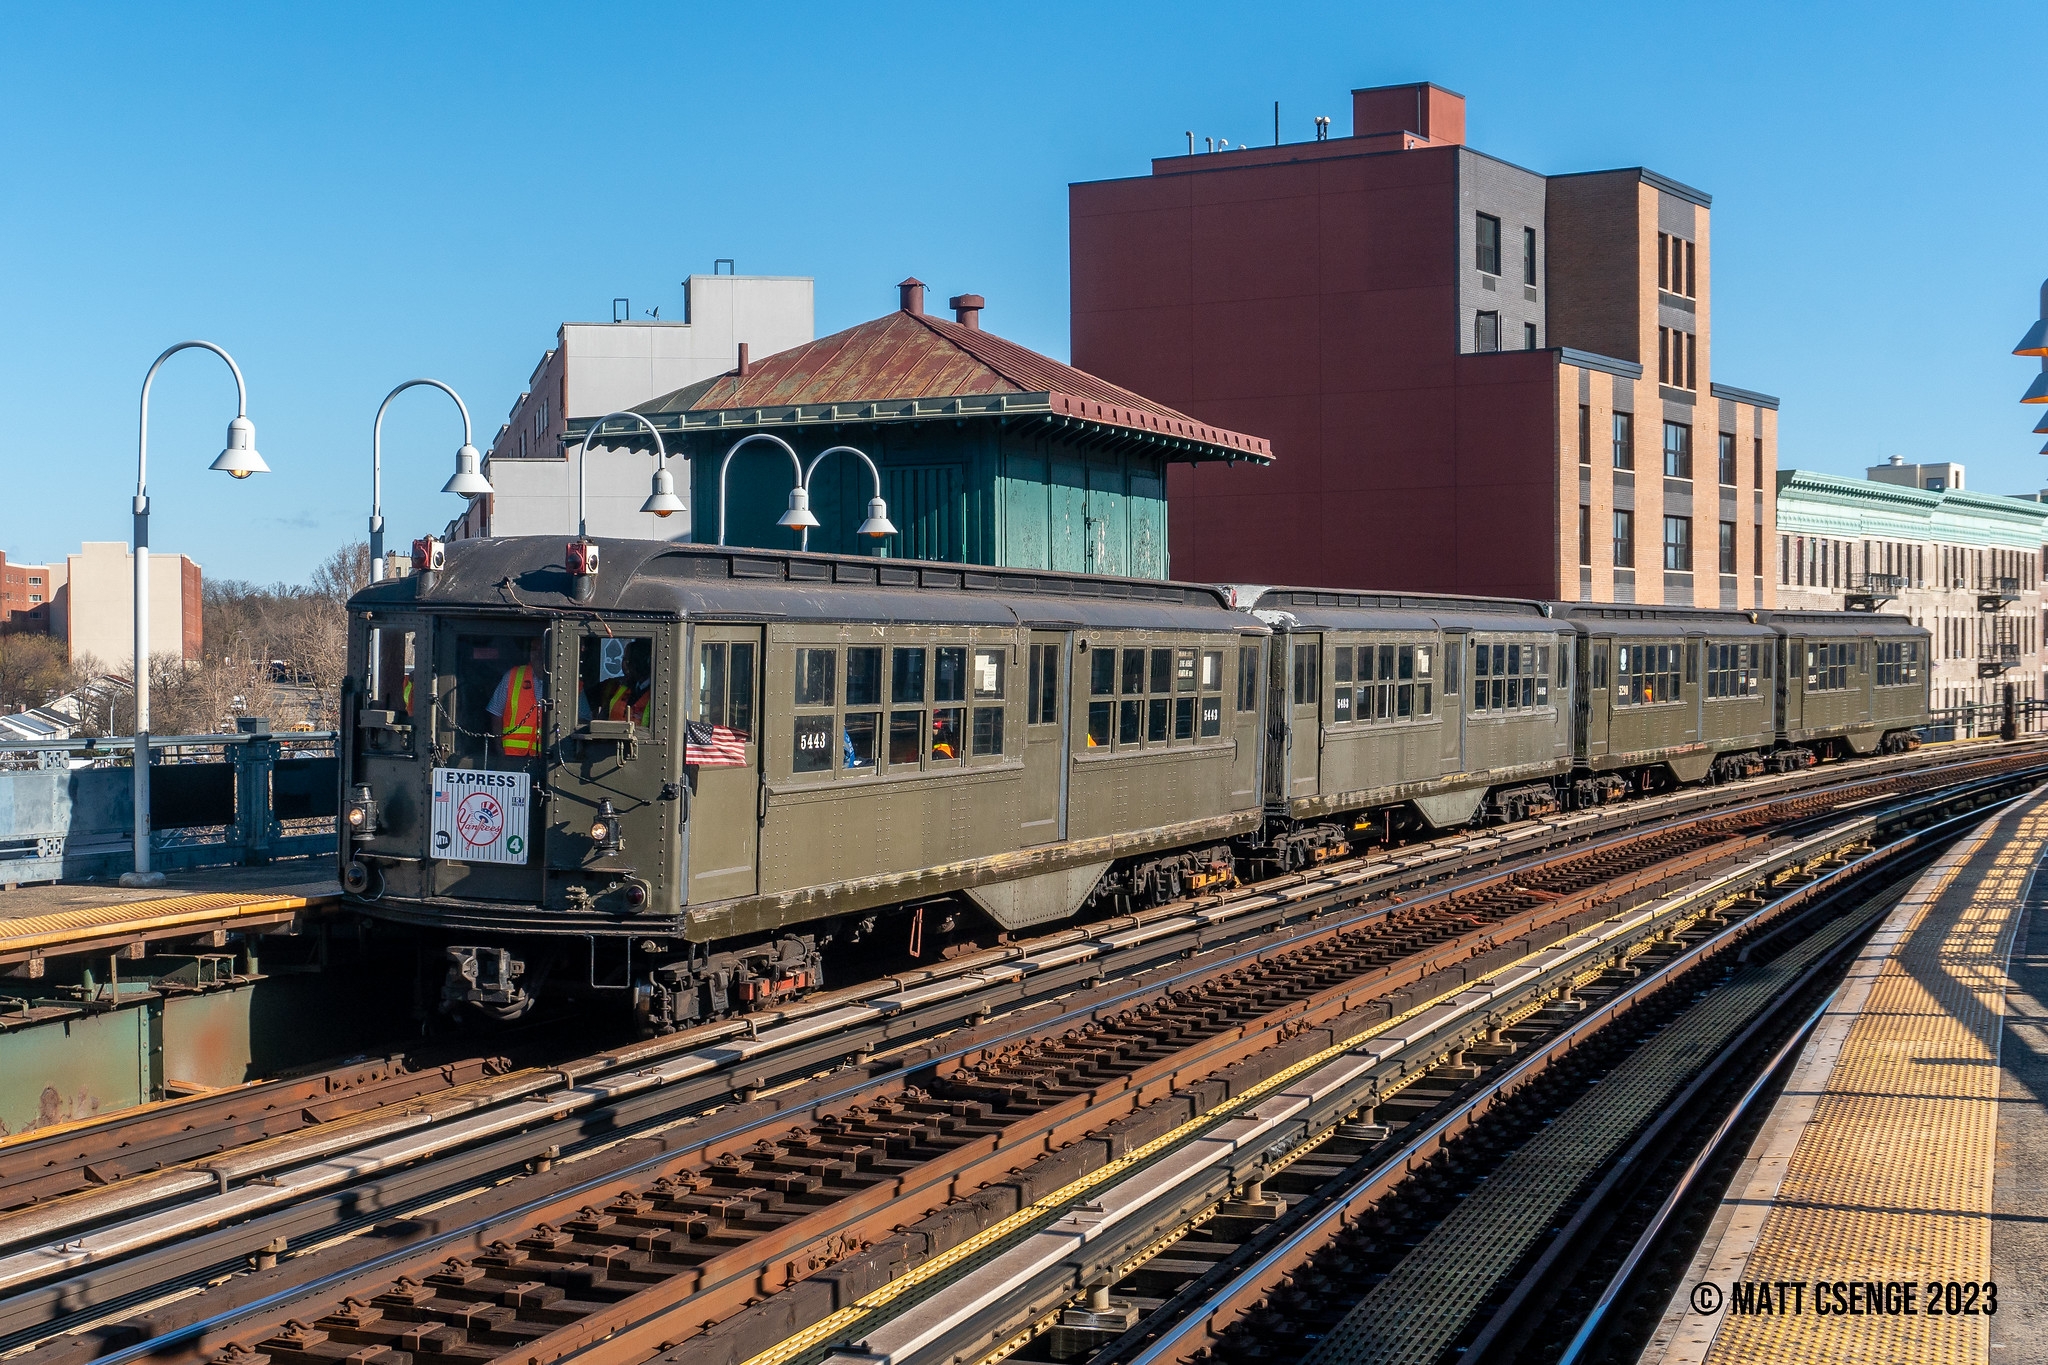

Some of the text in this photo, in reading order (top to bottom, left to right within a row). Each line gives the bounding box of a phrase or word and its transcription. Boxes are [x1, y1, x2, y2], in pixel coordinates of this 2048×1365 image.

[1203, 708, 1218, 721] 5443
[800, 731, 826, 750] 5443
[446, 771, 516, 788] EXPRESS
[457, 807, 503, 833] Yankees
[435, 834, 449, 846] MTA
[509, 837, 521, 852] 4
